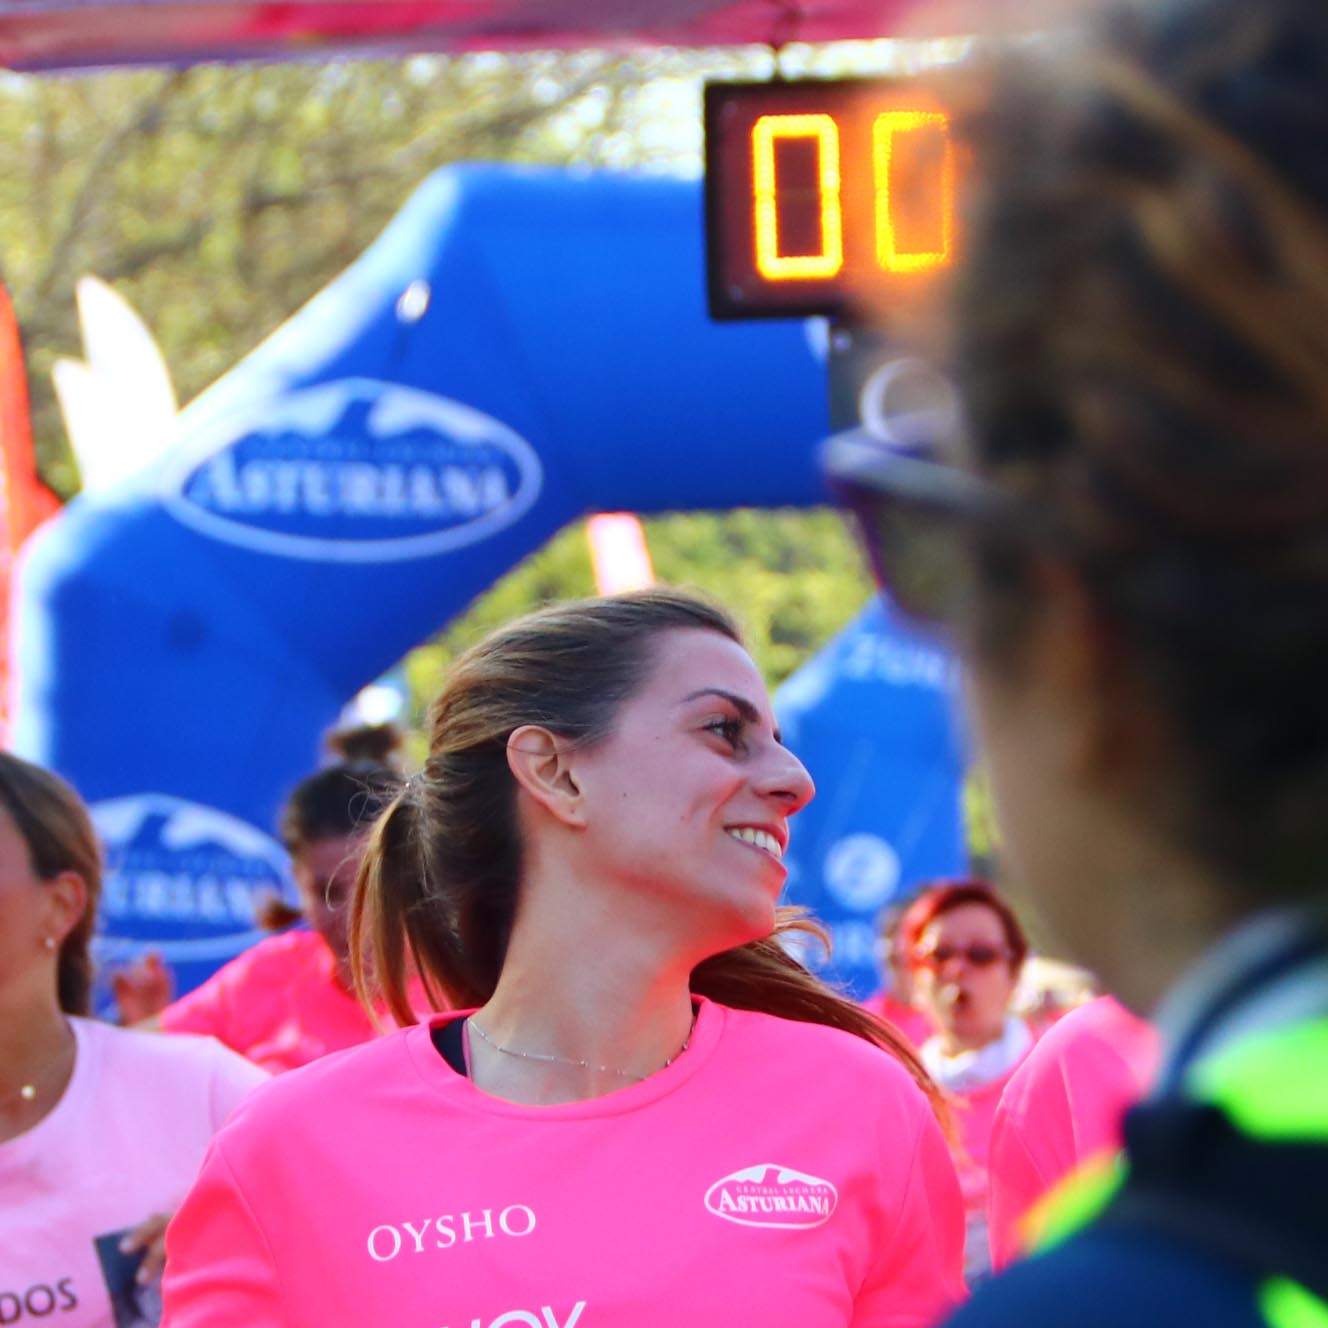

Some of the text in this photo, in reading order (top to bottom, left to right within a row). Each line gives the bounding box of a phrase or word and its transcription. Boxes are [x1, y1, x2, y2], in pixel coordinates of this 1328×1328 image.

[189, 442, 512, 518] ASTURIANA
[719, 1188, 829, 1215] ASTURIANA
[367, 1203, 537, 1263] OYSHO
